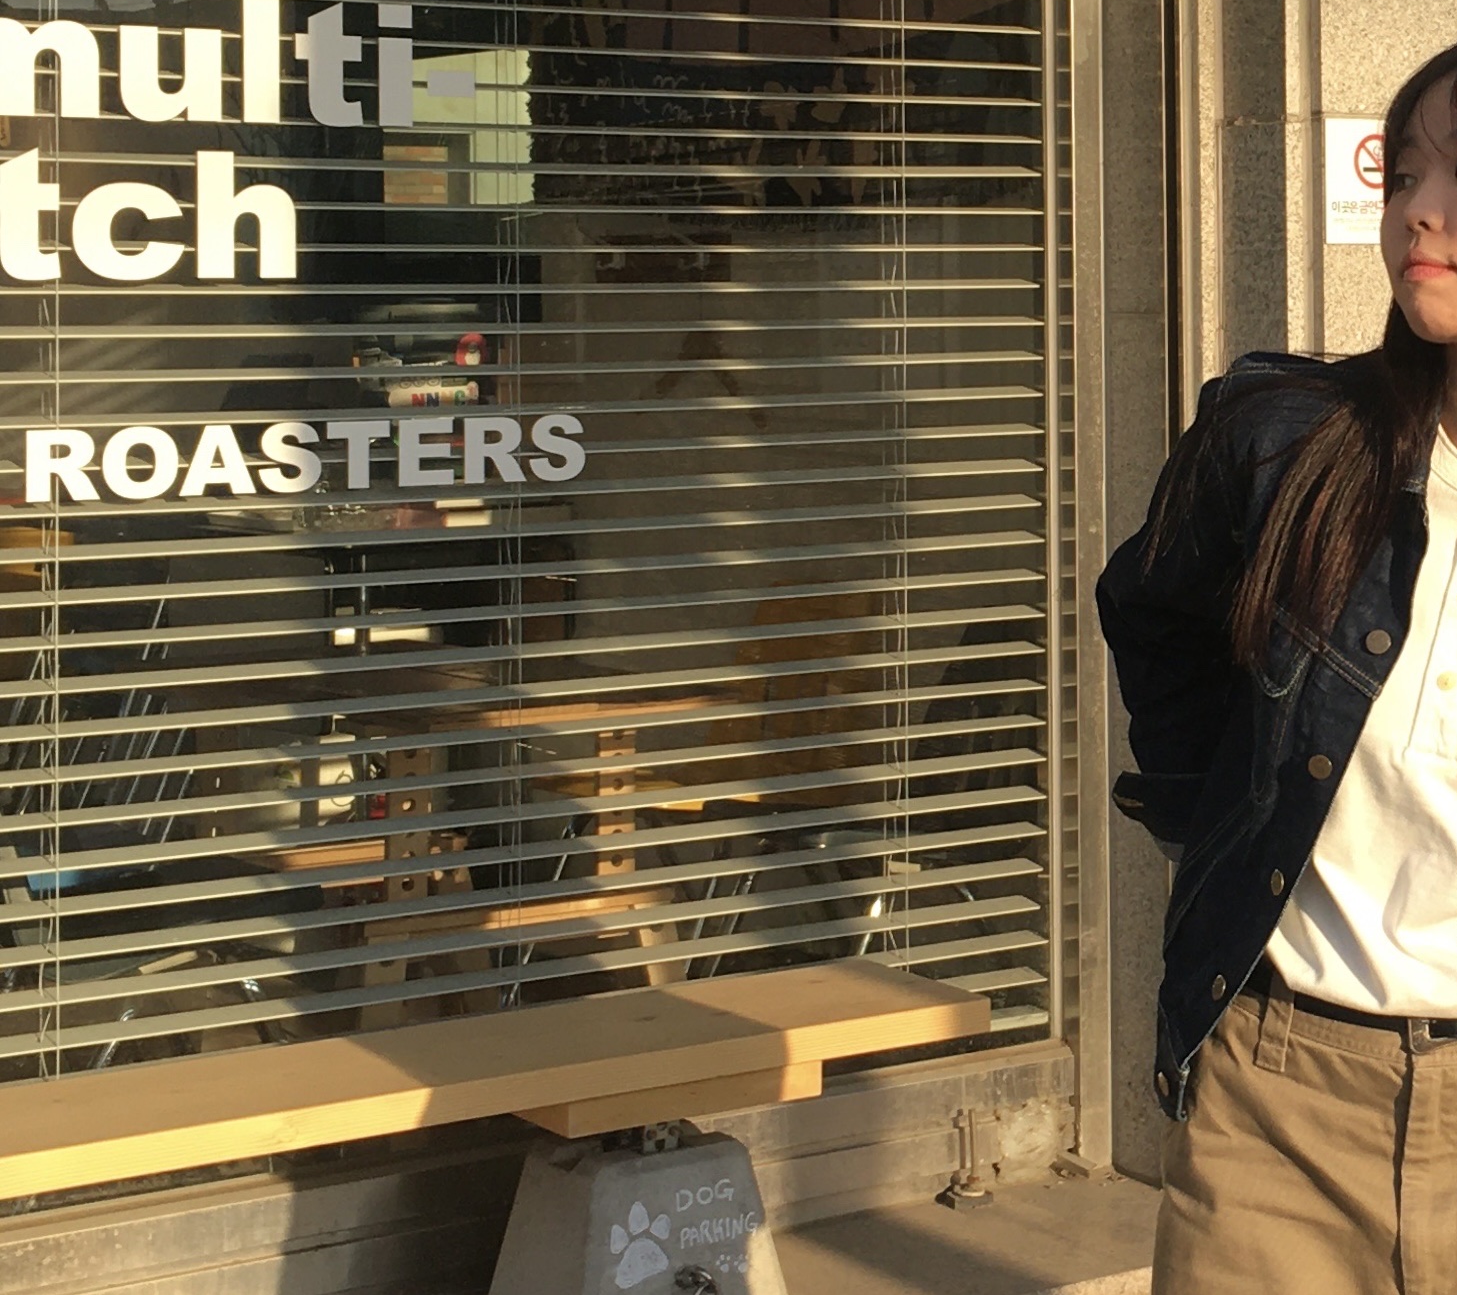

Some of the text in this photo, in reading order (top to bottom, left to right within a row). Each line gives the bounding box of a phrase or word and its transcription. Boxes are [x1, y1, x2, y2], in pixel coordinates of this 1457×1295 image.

[25, 414, 586, 503] ROASTERS
[675, 1178, 734, 1212] DOG
[679, 1211, 758, 1249] PARKING
